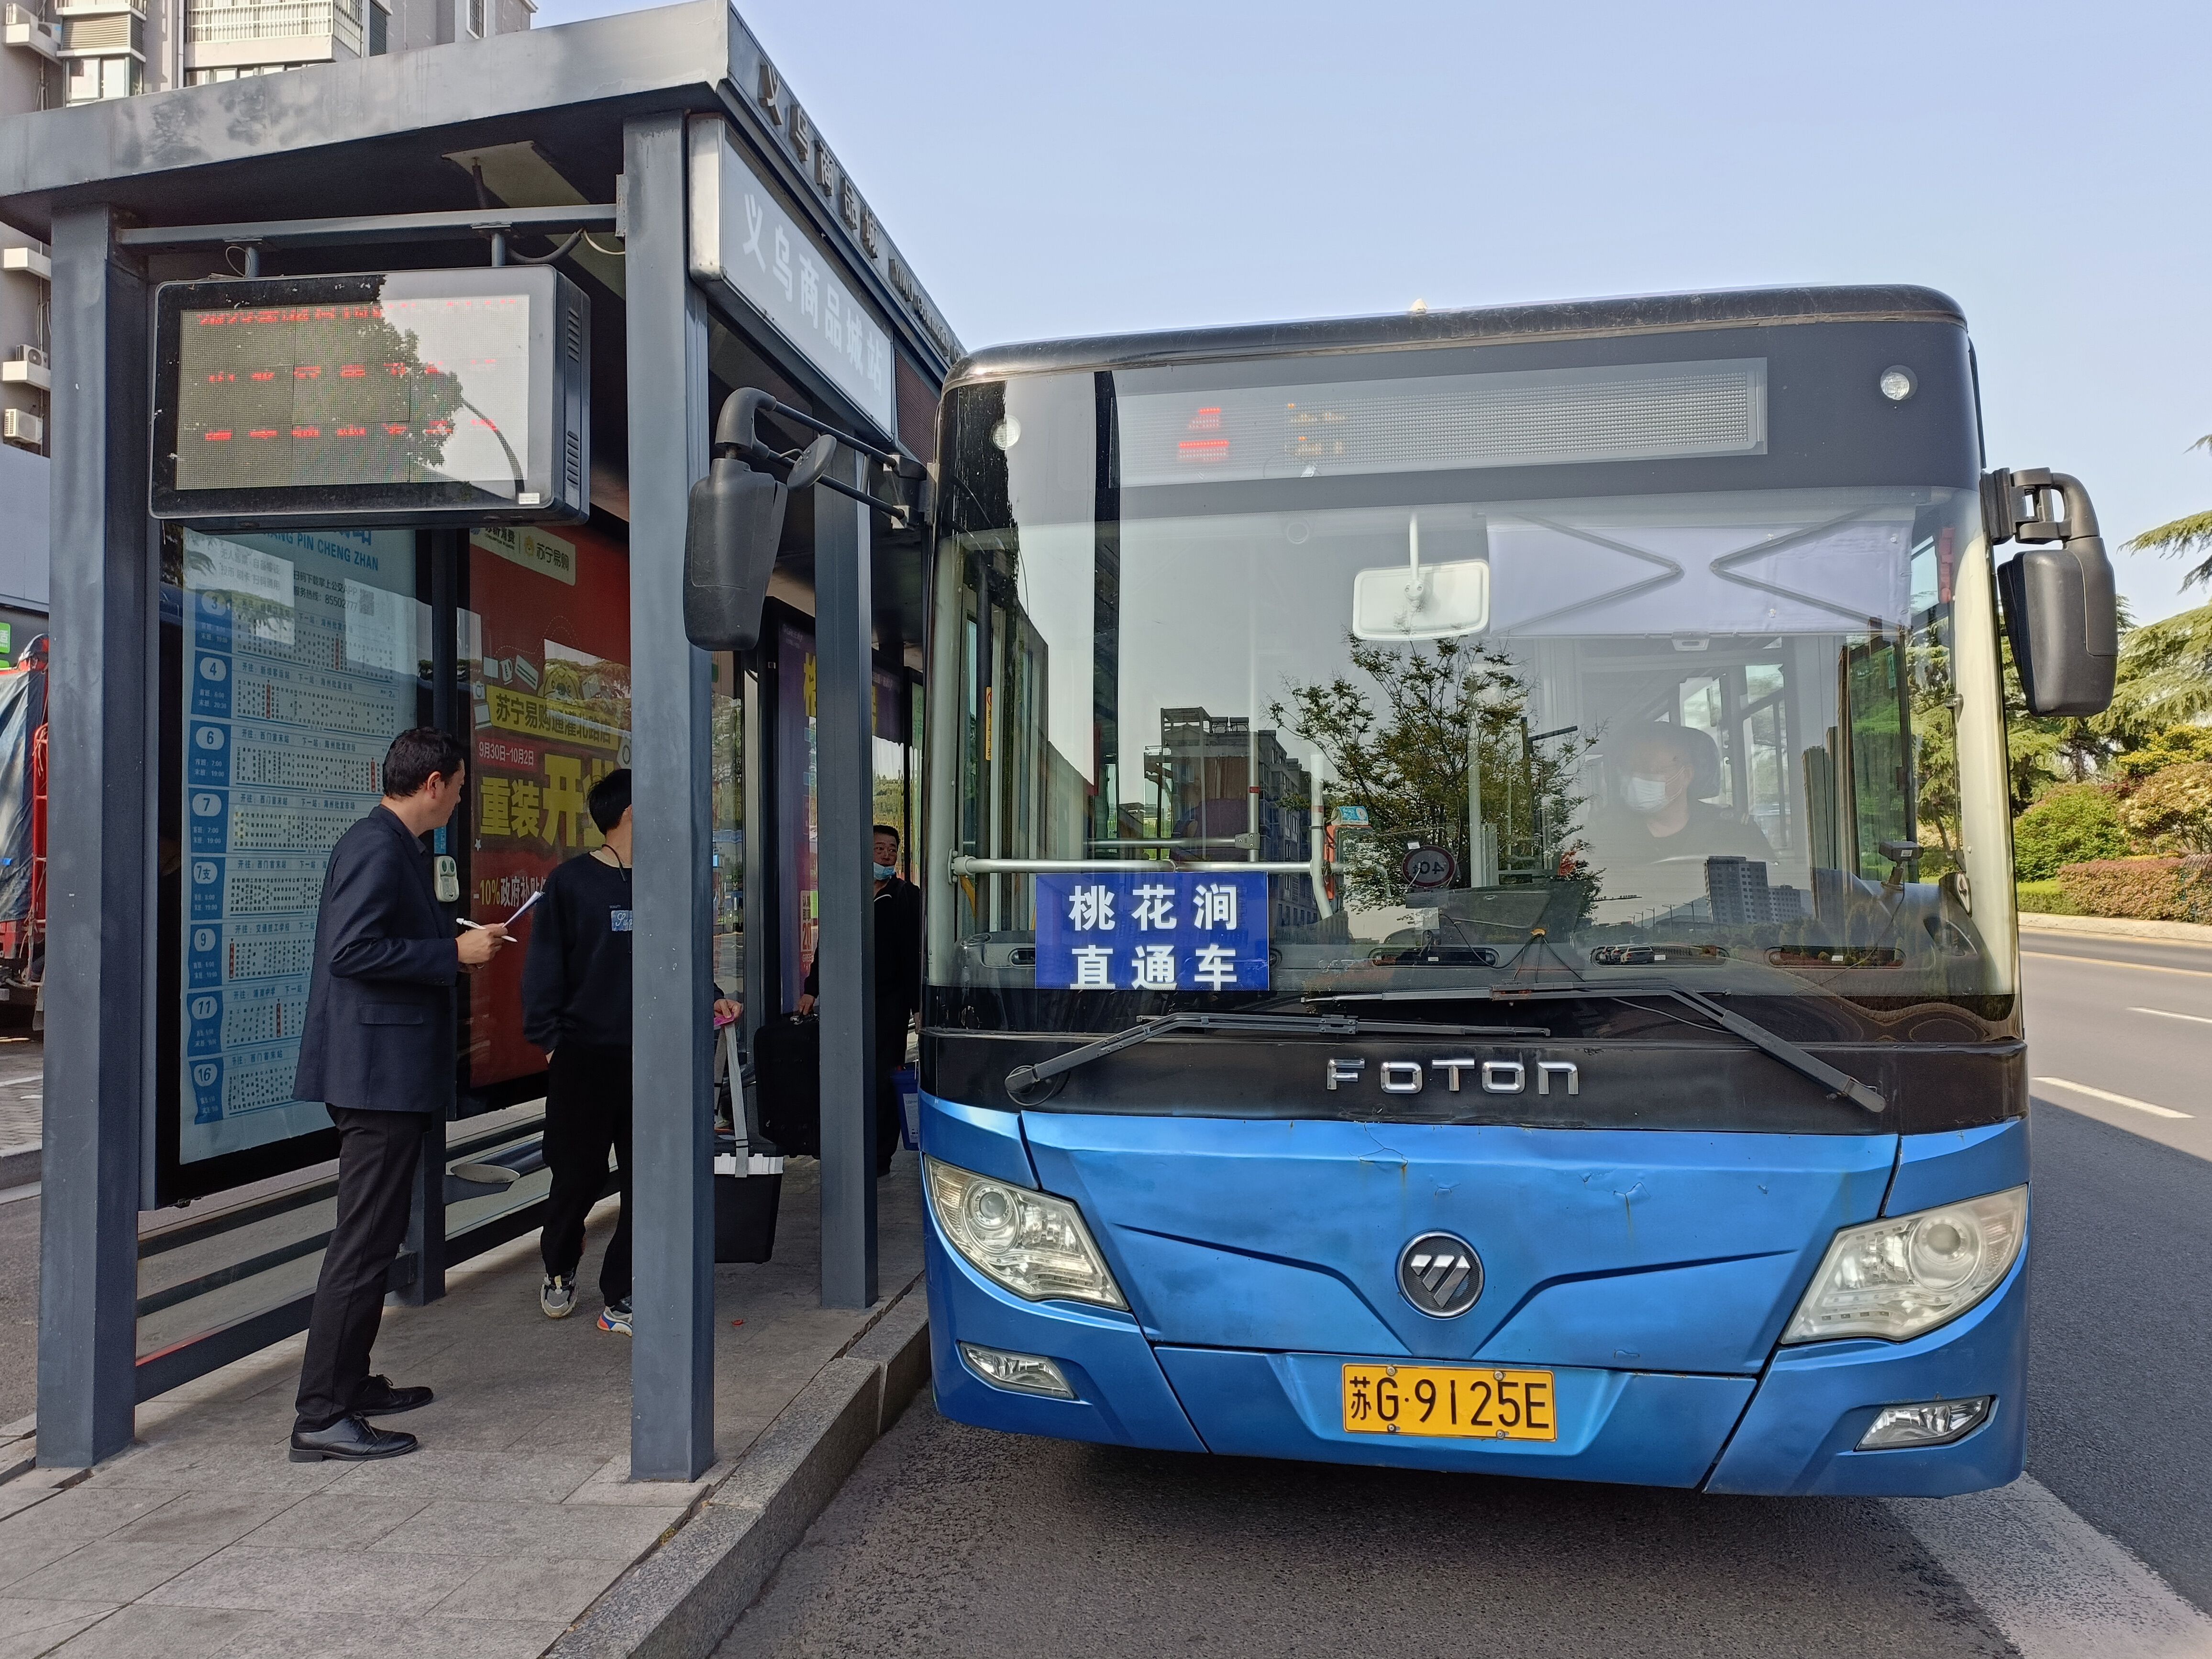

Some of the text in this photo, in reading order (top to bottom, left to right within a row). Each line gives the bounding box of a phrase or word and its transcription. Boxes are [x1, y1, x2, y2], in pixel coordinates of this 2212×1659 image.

[891, 260, 913, 301] YIWU
[742, 194, 883, 397] 义乌商品城站
[298, 533, 314, 551] PIN
[318, 539, 351, 562] CHENG
[354, 551, 378, 571] ZHAN
[537, 542, 569, 571] 苏宁易购
[211, 596, 218, 610] 3
[210, 662, 217, 676] 4
[496, 693, 611, 744] 苏宁易购通灌北路店
[206, 730, 214, 745] 6
[479, 741, 534, 766] 9月30日-10月2日
[203, 797, 210, 812] 7
[197, 865, 211, 880] 7支
[1068, 883, 1238, 931] 桃花涧
[200, 932, 207, 947] 9
[1069, 944, 1238, 992] 直通车
[198, 1000, 211, 1015] 11
[198, 1067, 211, 1082] 16
